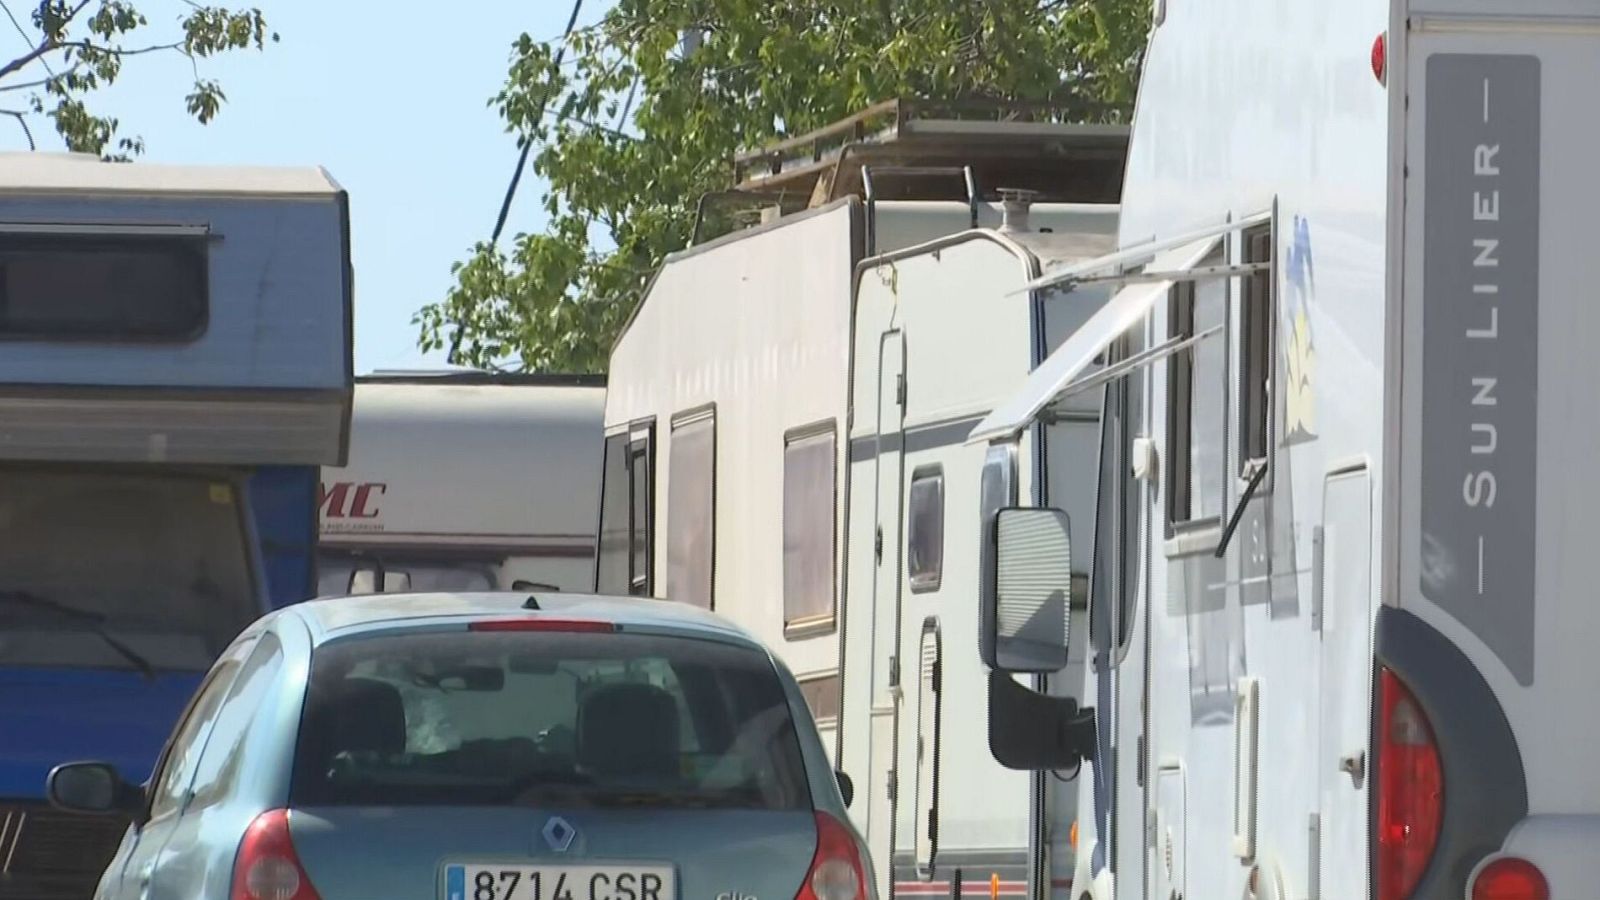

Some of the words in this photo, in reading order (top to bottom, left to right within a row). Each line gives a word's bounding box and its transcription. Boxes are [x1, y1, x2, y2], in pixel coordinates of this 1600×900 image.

[1466, 144, 1500, 338] LINER
[1463, 377, 1498, 508] SUN
[474, 870, 573, 900] 8714
[589, 872, 662, 900] CSR
